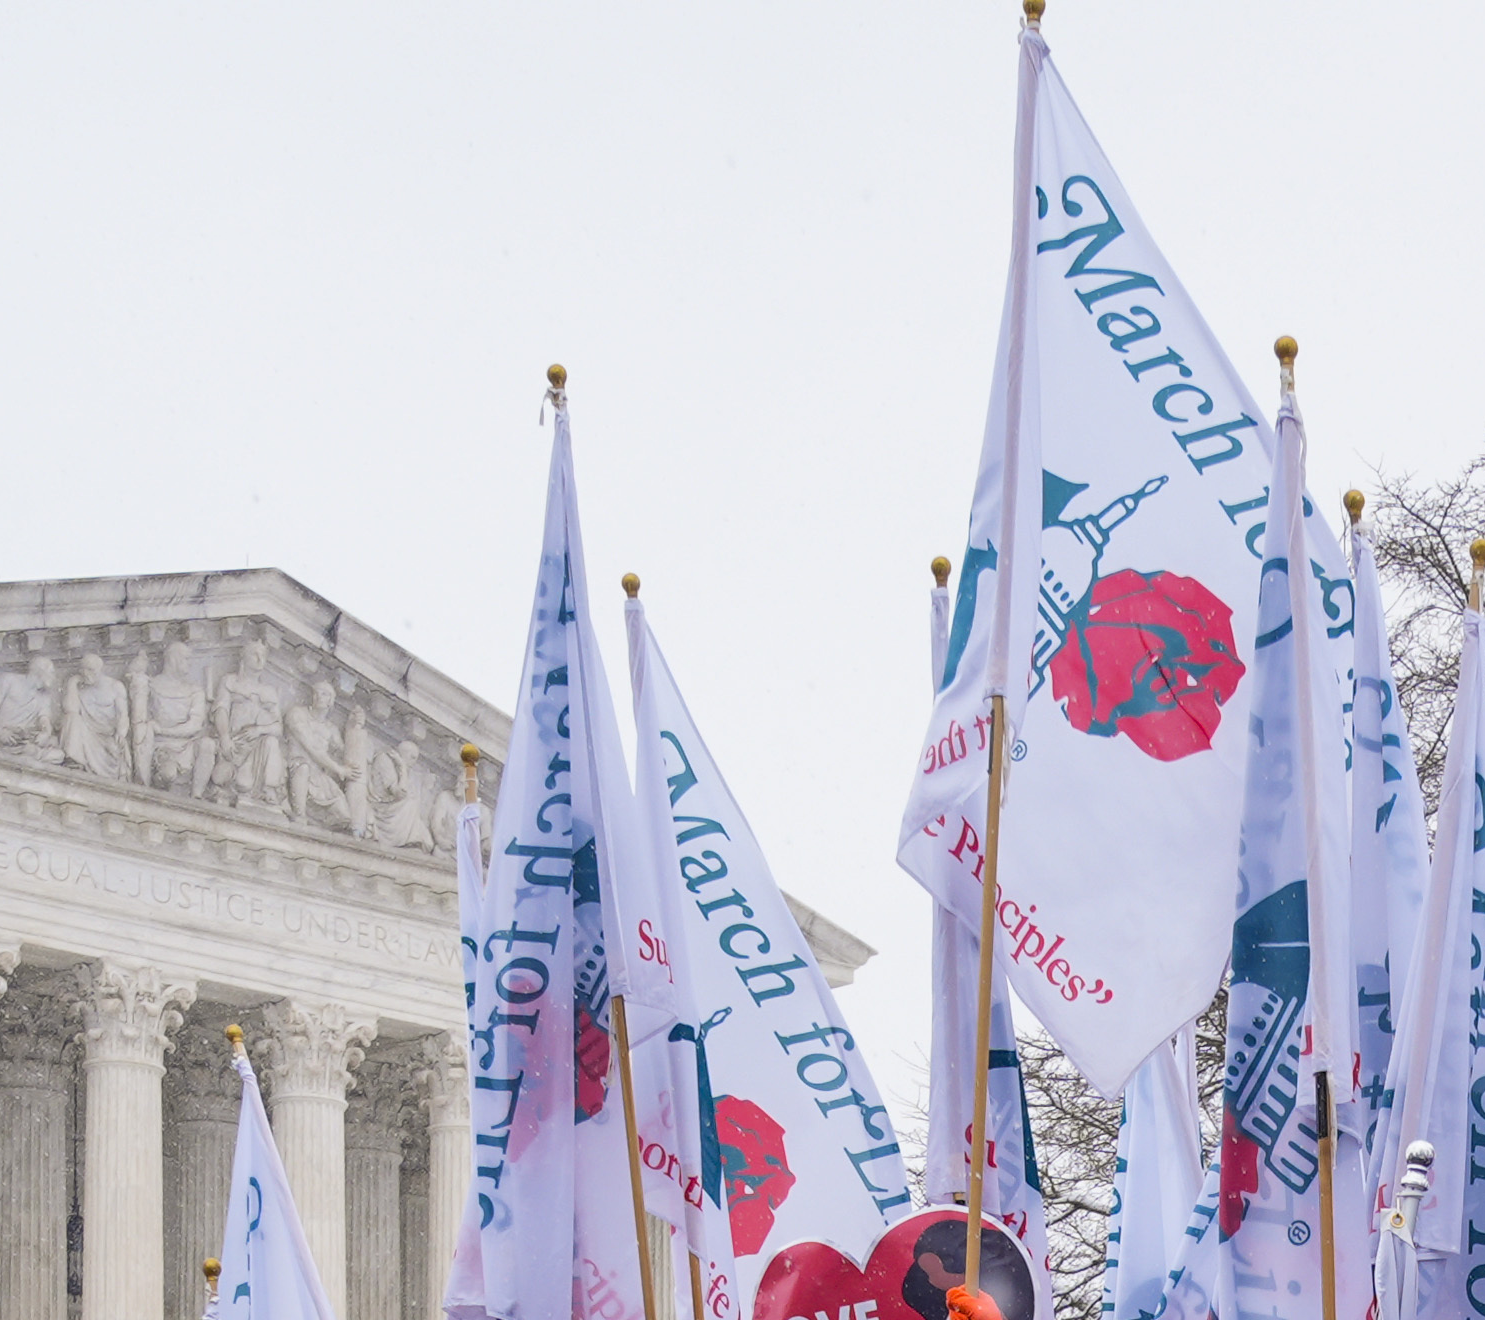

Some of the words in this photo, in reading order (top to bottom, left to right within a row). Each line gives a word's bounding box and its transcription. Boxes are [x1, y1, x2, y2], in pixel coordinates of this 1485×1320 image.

[1035, 174, 1259, 476] March
[127, 871, 265, 927] JUSTICE
[282, 900, 394, 953] UNDER
[773, 1021, 896, 1139] for
